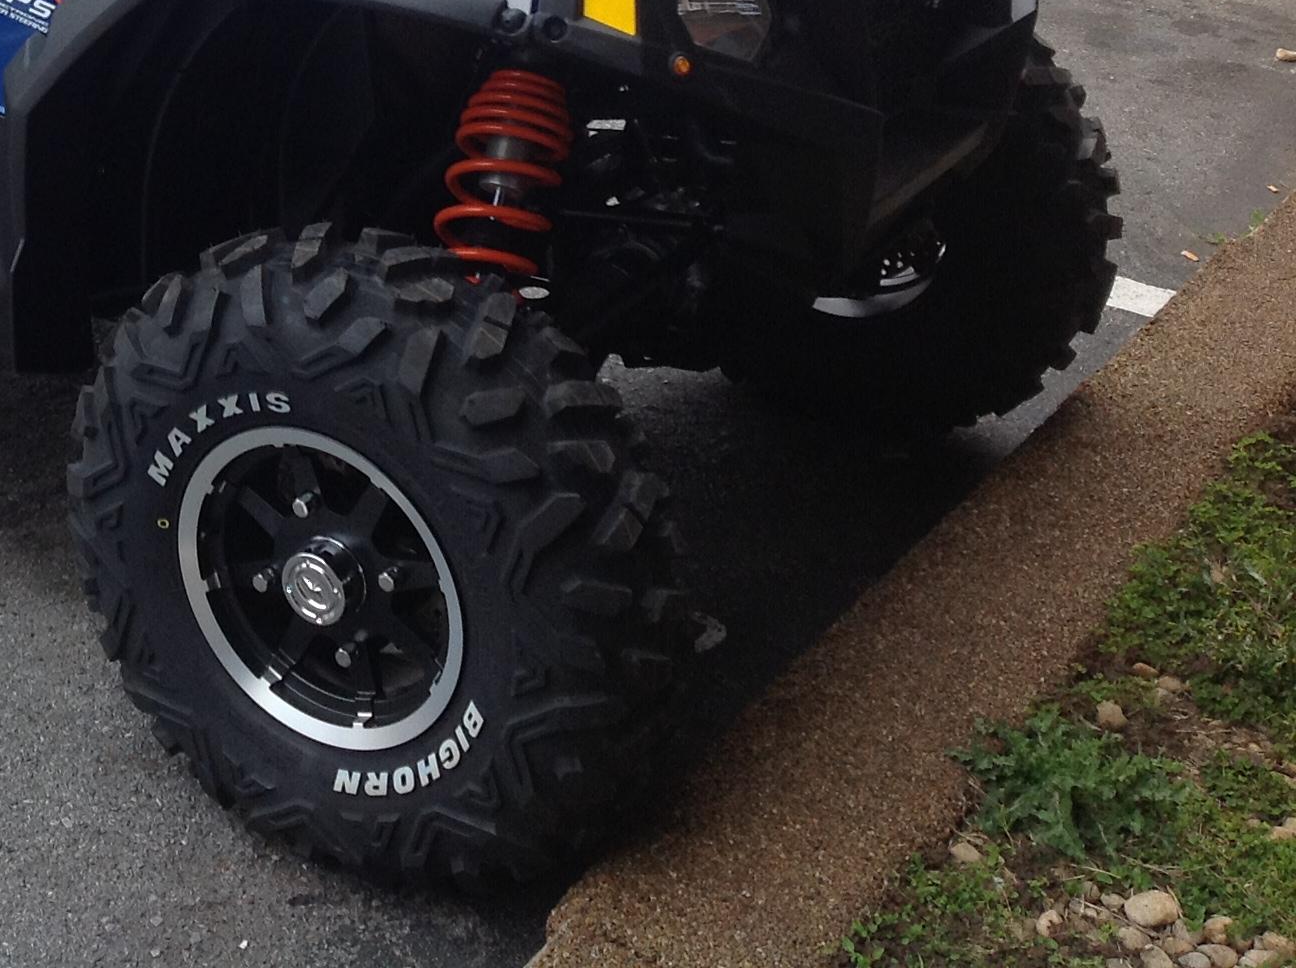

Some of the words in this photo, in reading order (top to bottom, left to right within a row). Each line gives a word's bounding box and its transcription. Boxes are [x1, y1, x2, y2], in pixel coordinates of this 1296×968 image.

[8, 13, 49, 34] STEERING
[146, 391, 292, 487] MAXXIS
[333, 700, 485, 797] BIGHORN
